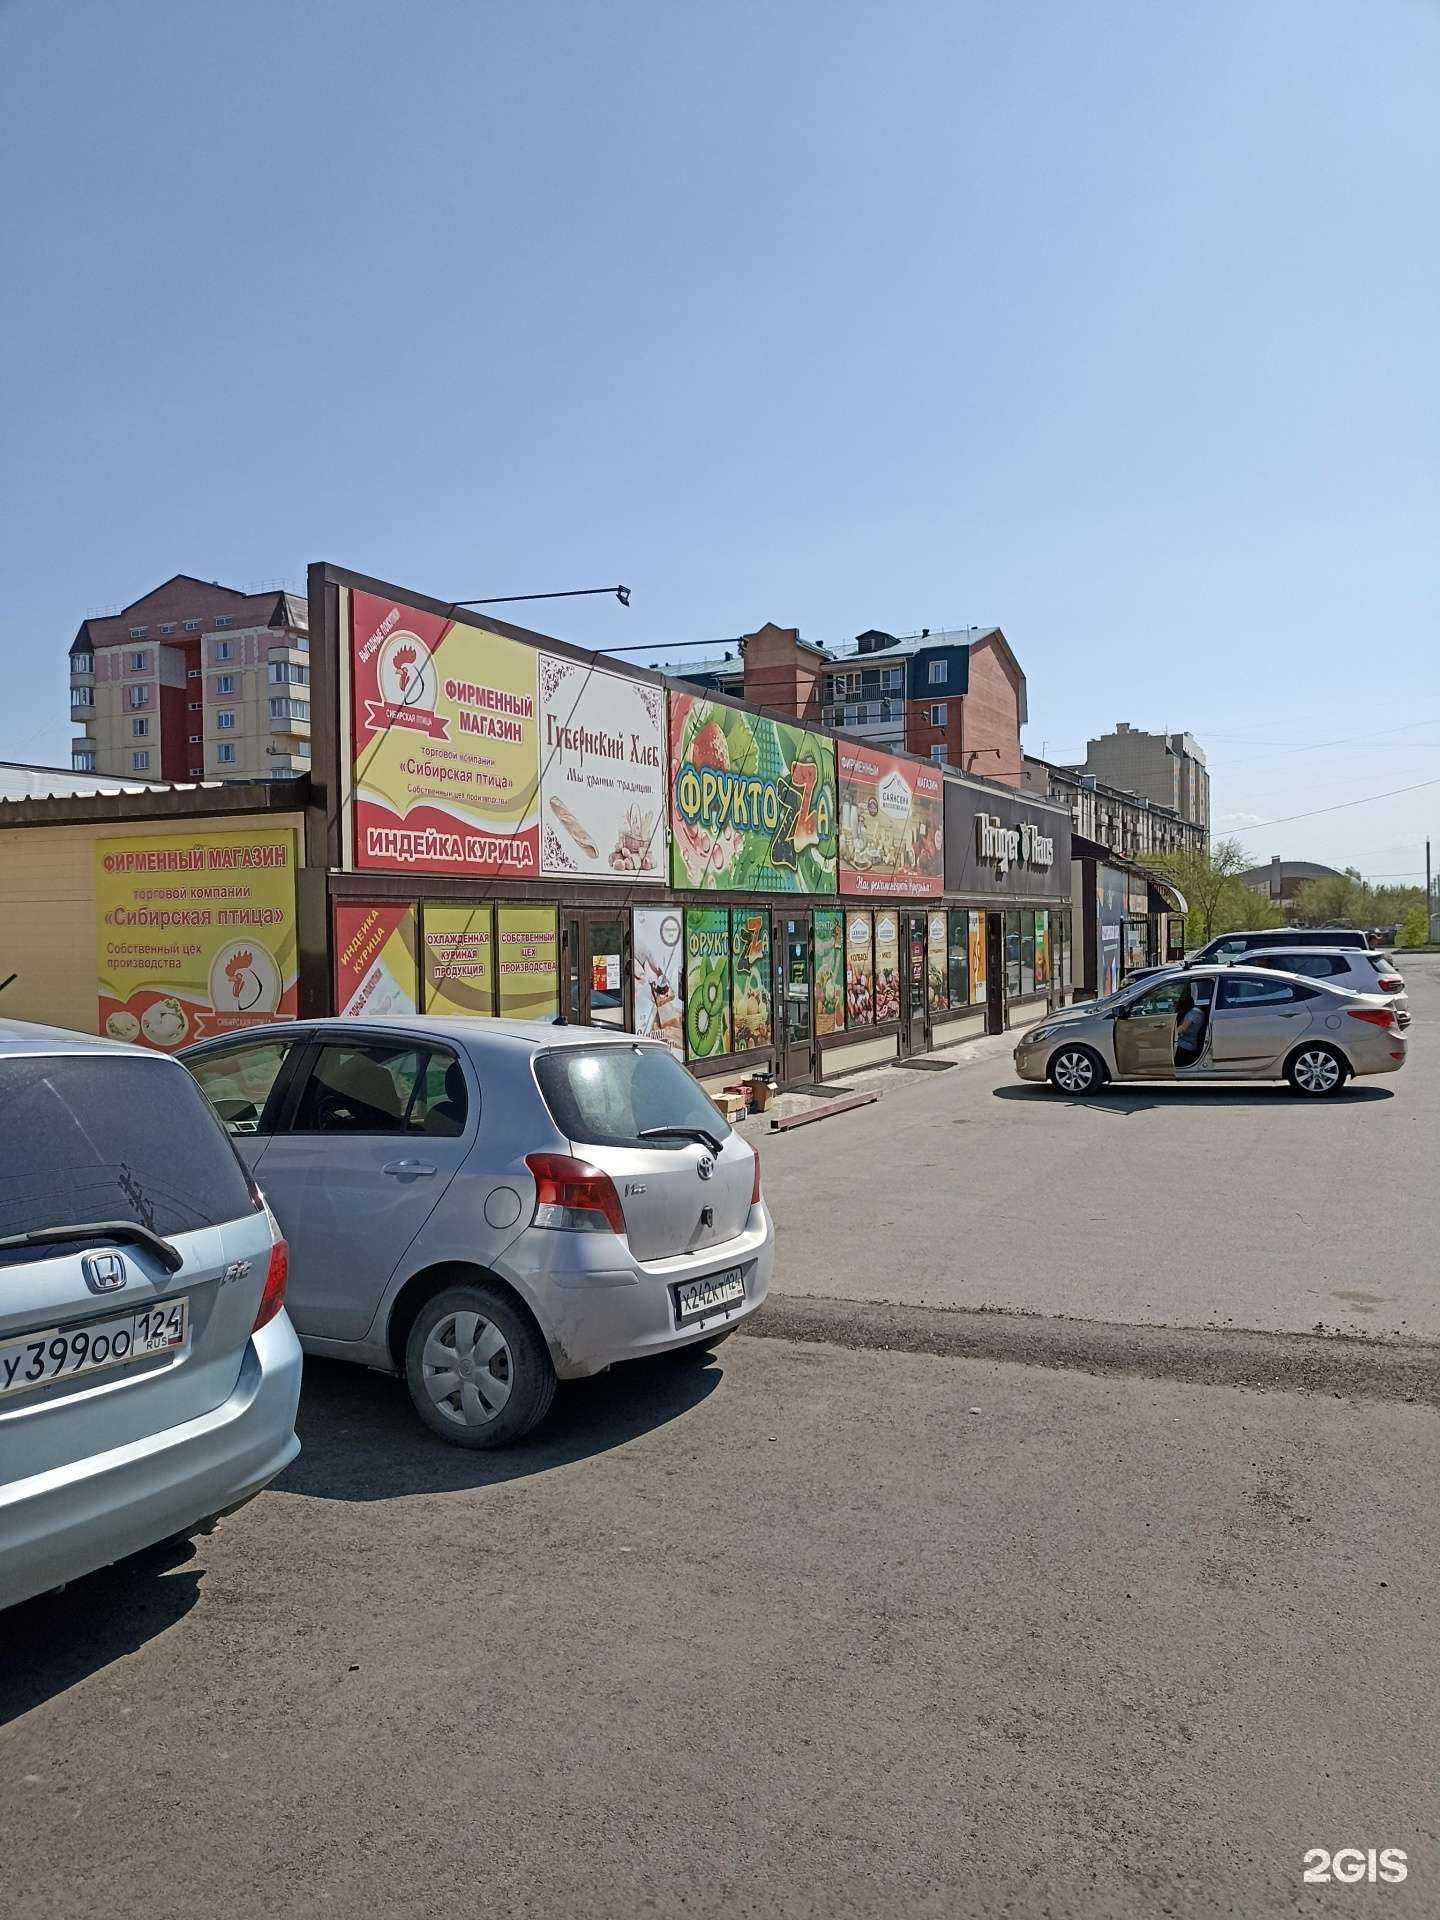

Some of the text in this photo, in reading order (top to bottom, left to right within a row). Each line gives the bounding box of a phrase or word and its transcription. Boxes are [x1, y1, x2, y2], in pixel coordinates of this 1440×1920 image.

[445, 680, 533, 718] ФИРМЕННЫЙ
[459, 711, 522, 743] МАГАЗИН
[400, 758, 513, 789] «Сибирская птица»
[841, 756, 880, 776] ФИРМЕННЫЙ
[567, 768, 584, 783] Мы
[368, 828, 534, 868] ИНДЕЙКА КУРИЦА
[103, 842, 288, 873] ФИРМЕННЫЙ МАГАЗИН
[133, 886, 188, 901] торговой
[105, 906, 285, 930] «Сибирская птица»
[340, 909, 380, 966] ИНДЕЙКА
[427, 931, 490, 945] ОХЛАЖДЕННАЯ
[501, 931, 555, 944] СОБСТВЕННЫЙ
[106, 942, 202, 957] Собственный цех
[353, 927, 385, 974] КУРИЦА
[440, 949, 478, 961] КУРИНАЯ
[521, 948, 537, 959] ЦЕХ
[107, 957, 182, 970] производства
[434, 963, 484, 979] ПРОДУКЦИЯ
[500, 961, 558, 974] ПРОИЗВОДСТВА
[138, 1307, 181, 1342] 124
[146, 1336, 168, 1350] RUS
